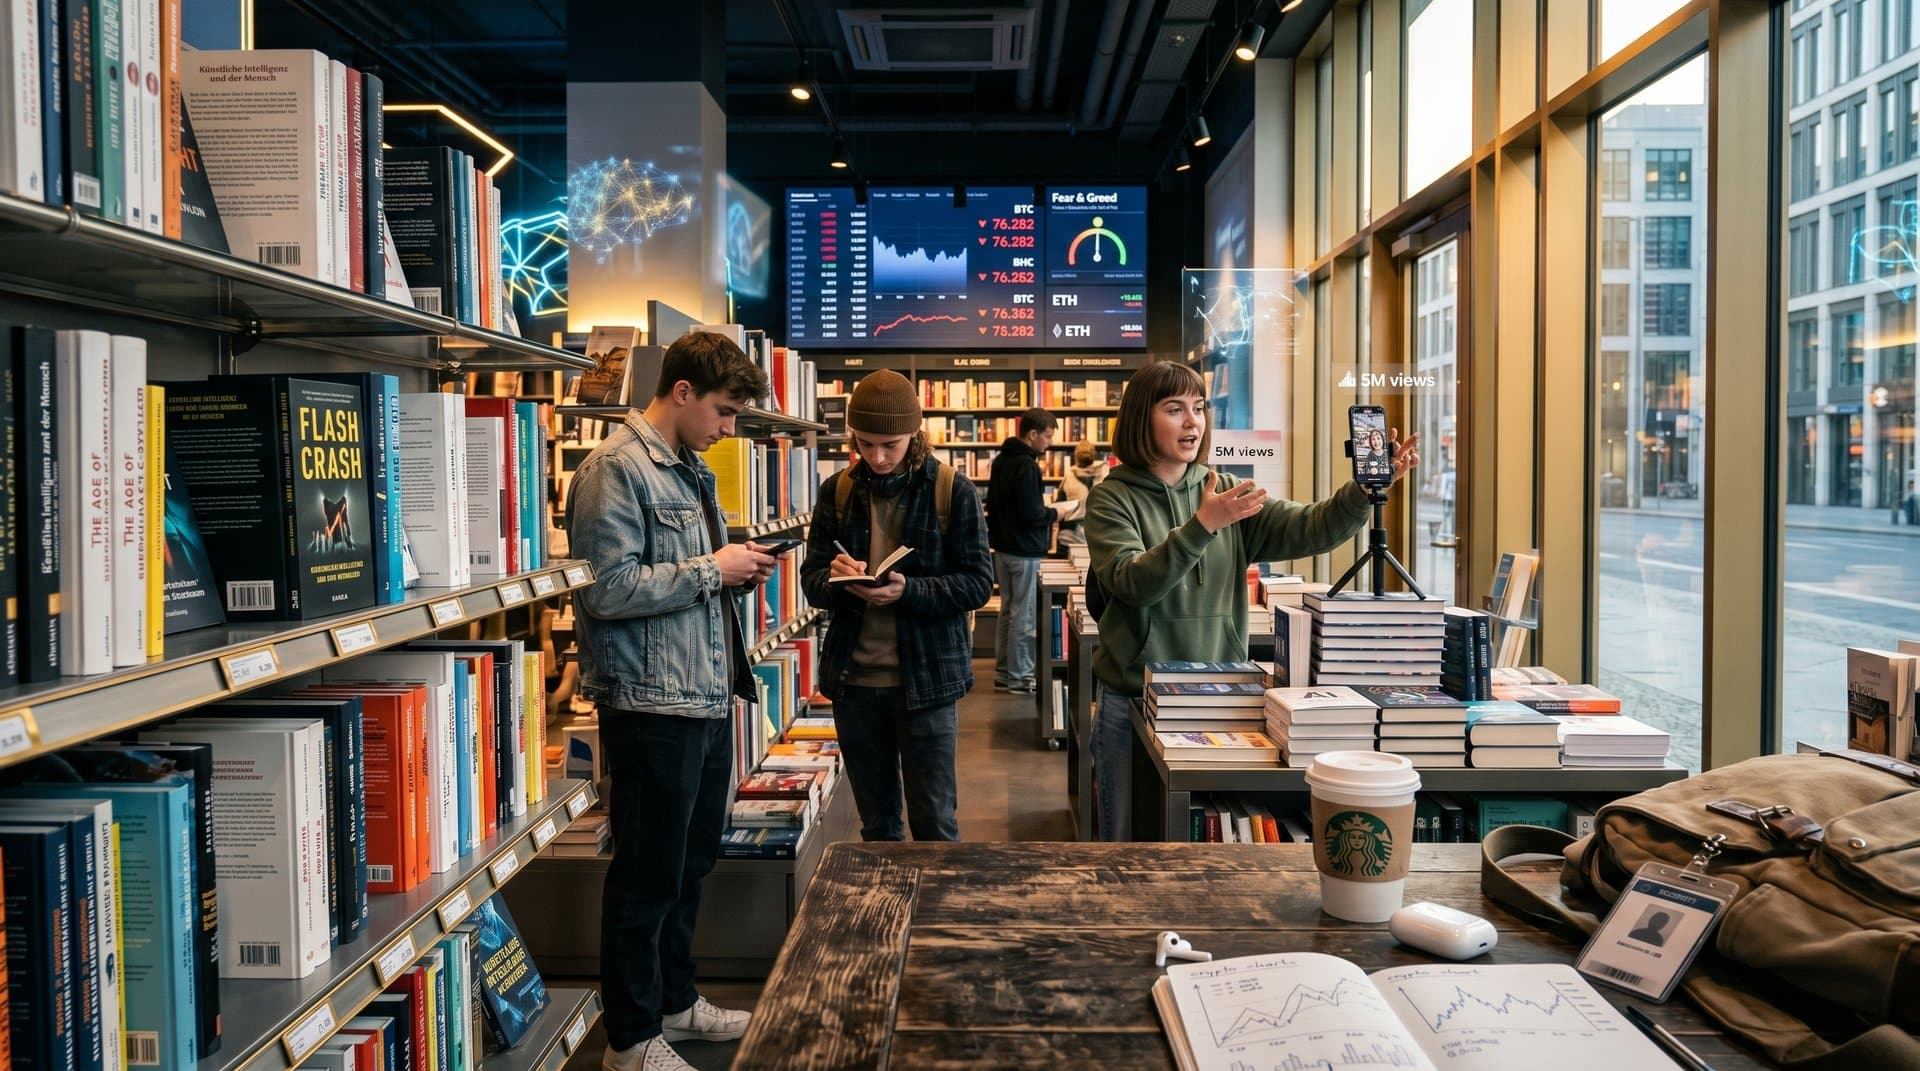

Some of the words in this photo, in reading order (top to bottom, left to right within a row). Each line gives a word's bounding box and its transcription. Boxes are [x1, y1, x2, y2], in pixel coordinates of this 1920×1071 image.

[199, 65, 242, 73] Künstliche
[227, 74, 242, 82] der
[243, 74, 276, 82] Mensch
[1052, 192, 1075, 203] Fear
[1076, 192, 1085, 203] &
[1086, 192, 1118, 203] Greed
[1013, 204, 1034, 214] BTC
[992, 218, 1035, 230] 76.282
[992, 236, 1035, 247] 76.282
[1012, 257, 1034, 267] BHC
[1013, 294, 1034, 304] BTC
[1052, 294, 1078, 306] ETH
[1065, 324, 1091, 337] ETH
[299, 407, 360, 443] FLASH
[300, 446, 362, 480] CRASH
[91, 513, 102, 549] THE
[123, 513, 135, 548] THE
[1303, 691, 1338, 699] AI
